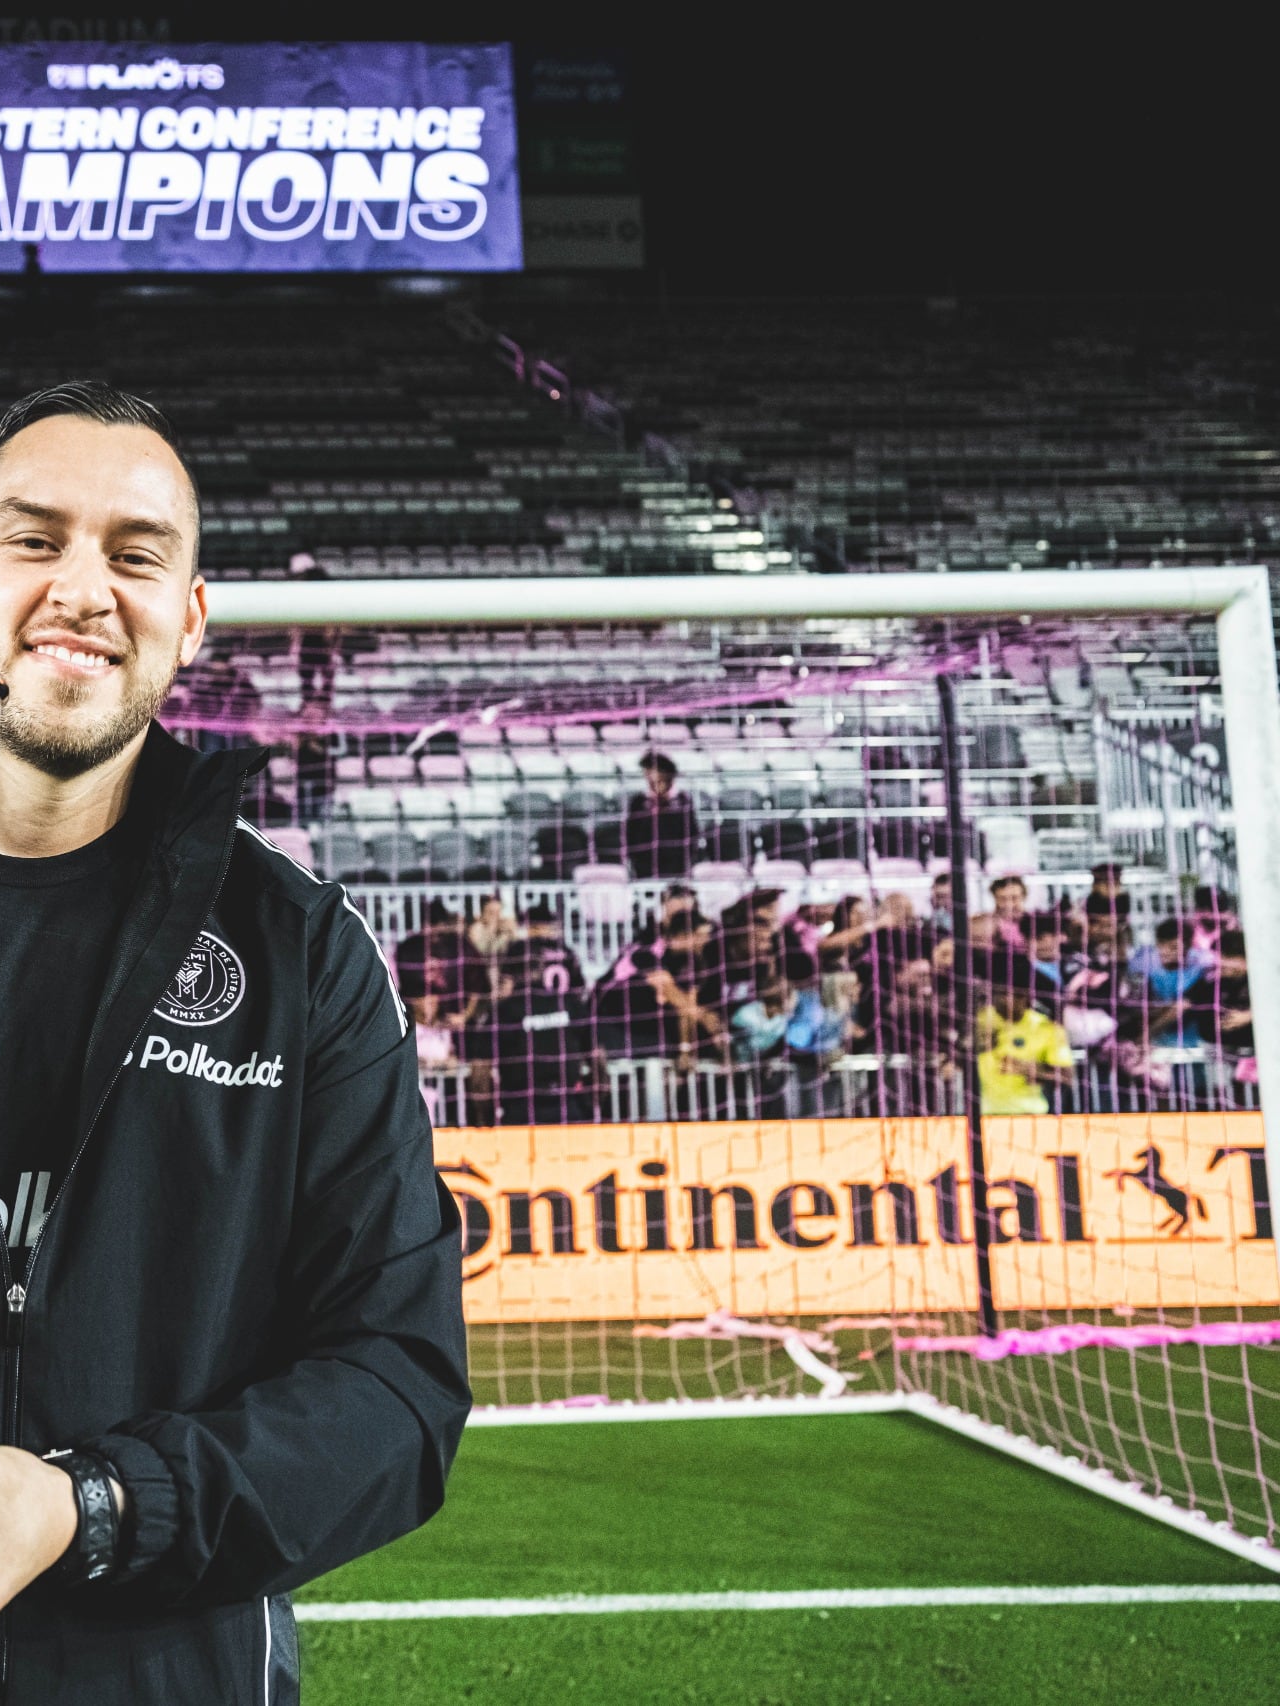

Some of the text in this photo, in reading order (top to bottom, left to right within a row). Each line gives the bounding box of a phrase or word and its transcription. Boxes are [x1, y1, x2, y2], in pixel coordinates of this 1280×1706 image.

[139, 106, 486, 150] CONFERENCE
[219, 951, 240, 1005] DE FÚTBOL
[170, 1007, 206, 1020] MMXX
[139, 1035, 284, 1088] Polkadot
[434, 1157, 1095, 1281] ntinental
